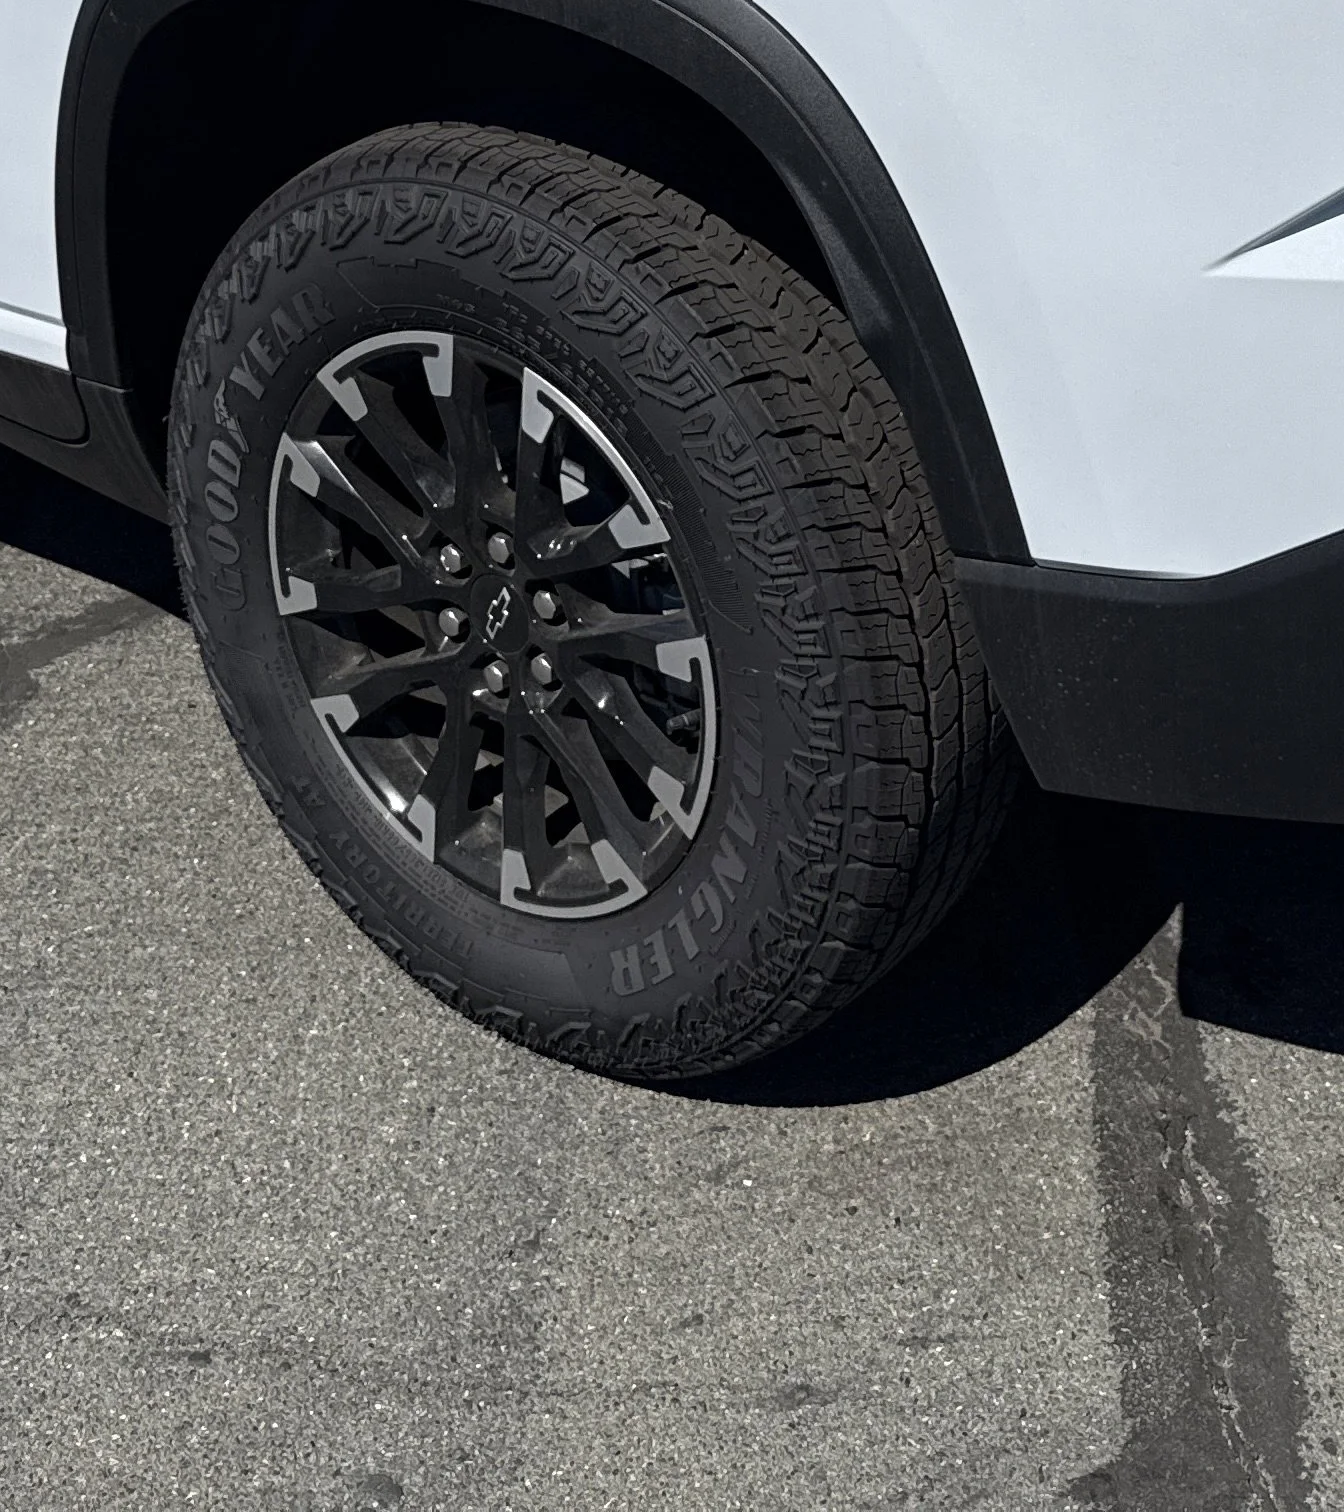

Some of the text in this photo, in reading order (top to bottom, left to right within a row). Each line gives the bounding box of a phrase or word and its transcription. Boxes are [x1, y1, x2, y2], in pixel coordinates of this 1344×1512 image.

[204, 281, 337, 612] GOODYEAR
[329, 830, 475, 959] TERRITORY
[610, 674, 766, 996] WRANGLER
